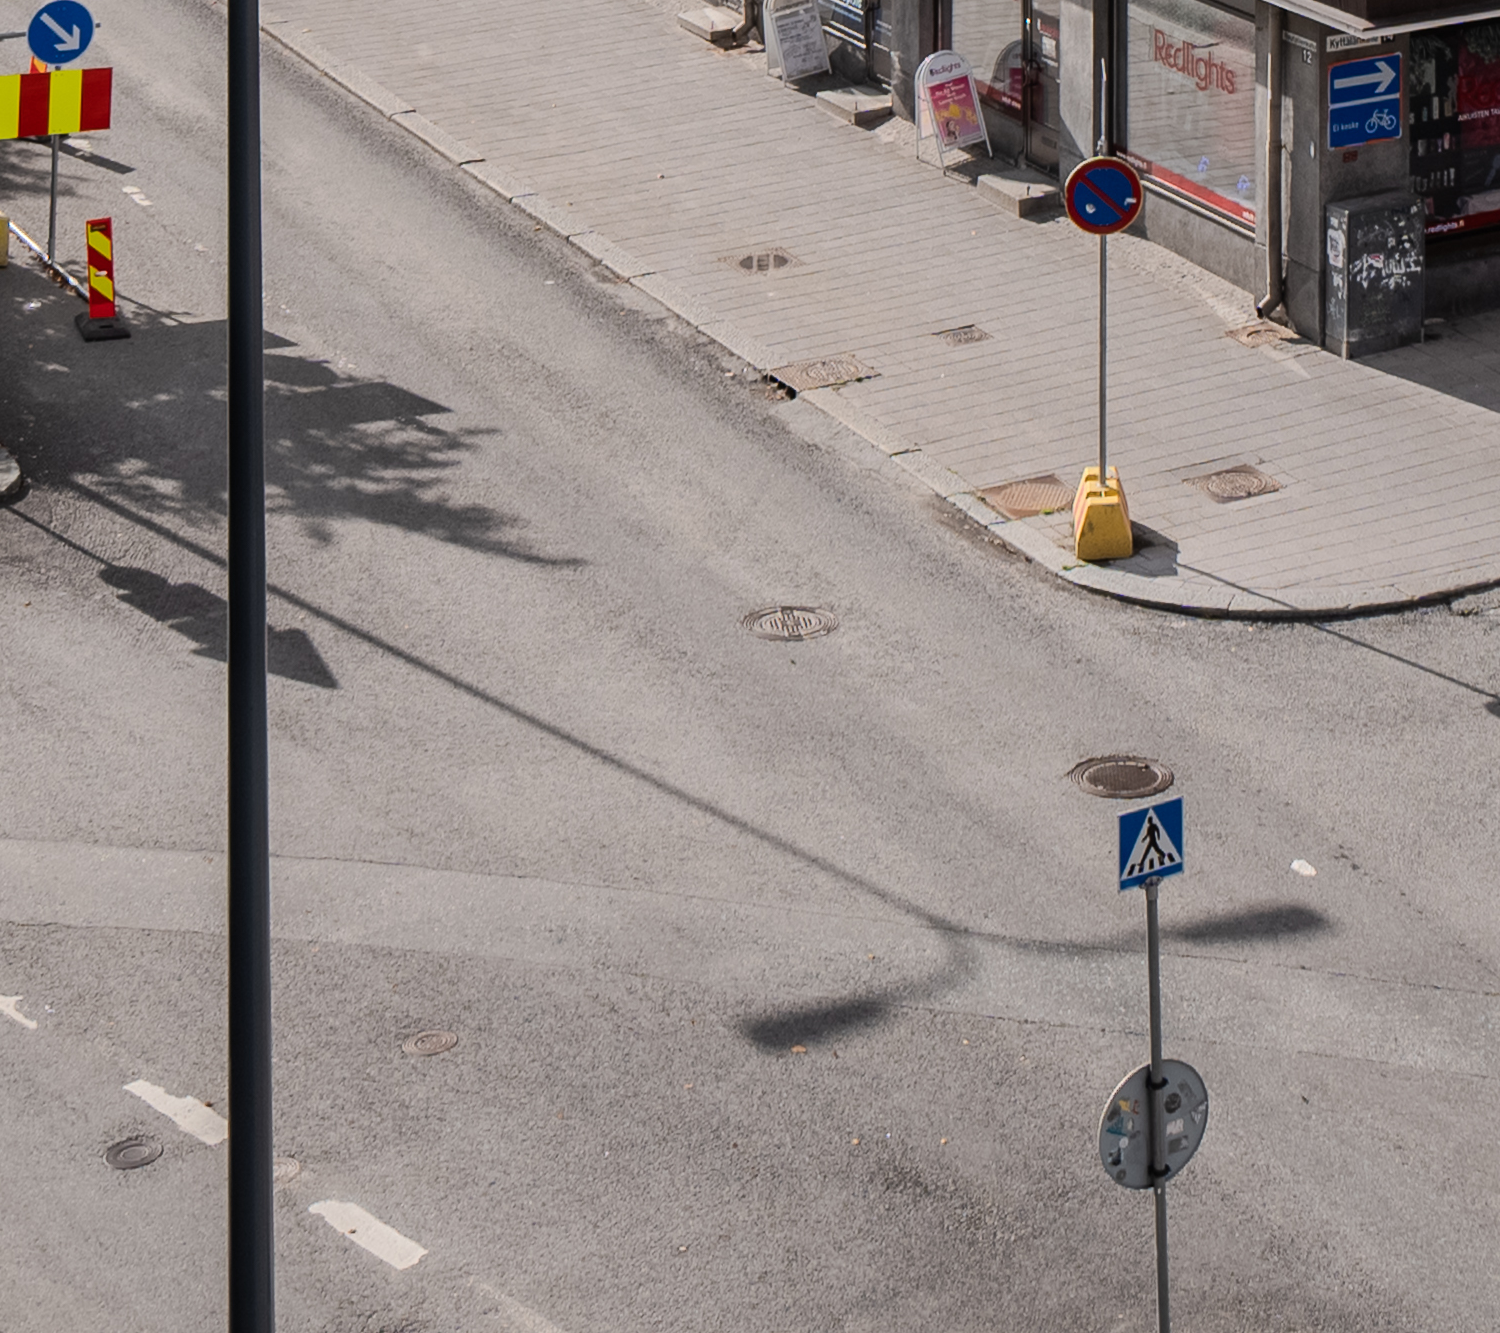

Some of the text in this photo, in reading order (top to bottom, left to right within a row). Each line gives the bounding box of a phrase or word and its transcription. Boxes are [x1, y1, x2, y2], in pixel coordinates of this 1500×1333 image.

[1154, 28, 1236, 95] Redlights
[1303, 49, 1312, 64] 12
[929, 62, 961, 77] Redlights
[1457, 108, 1490, 122] AIKUISTEN
